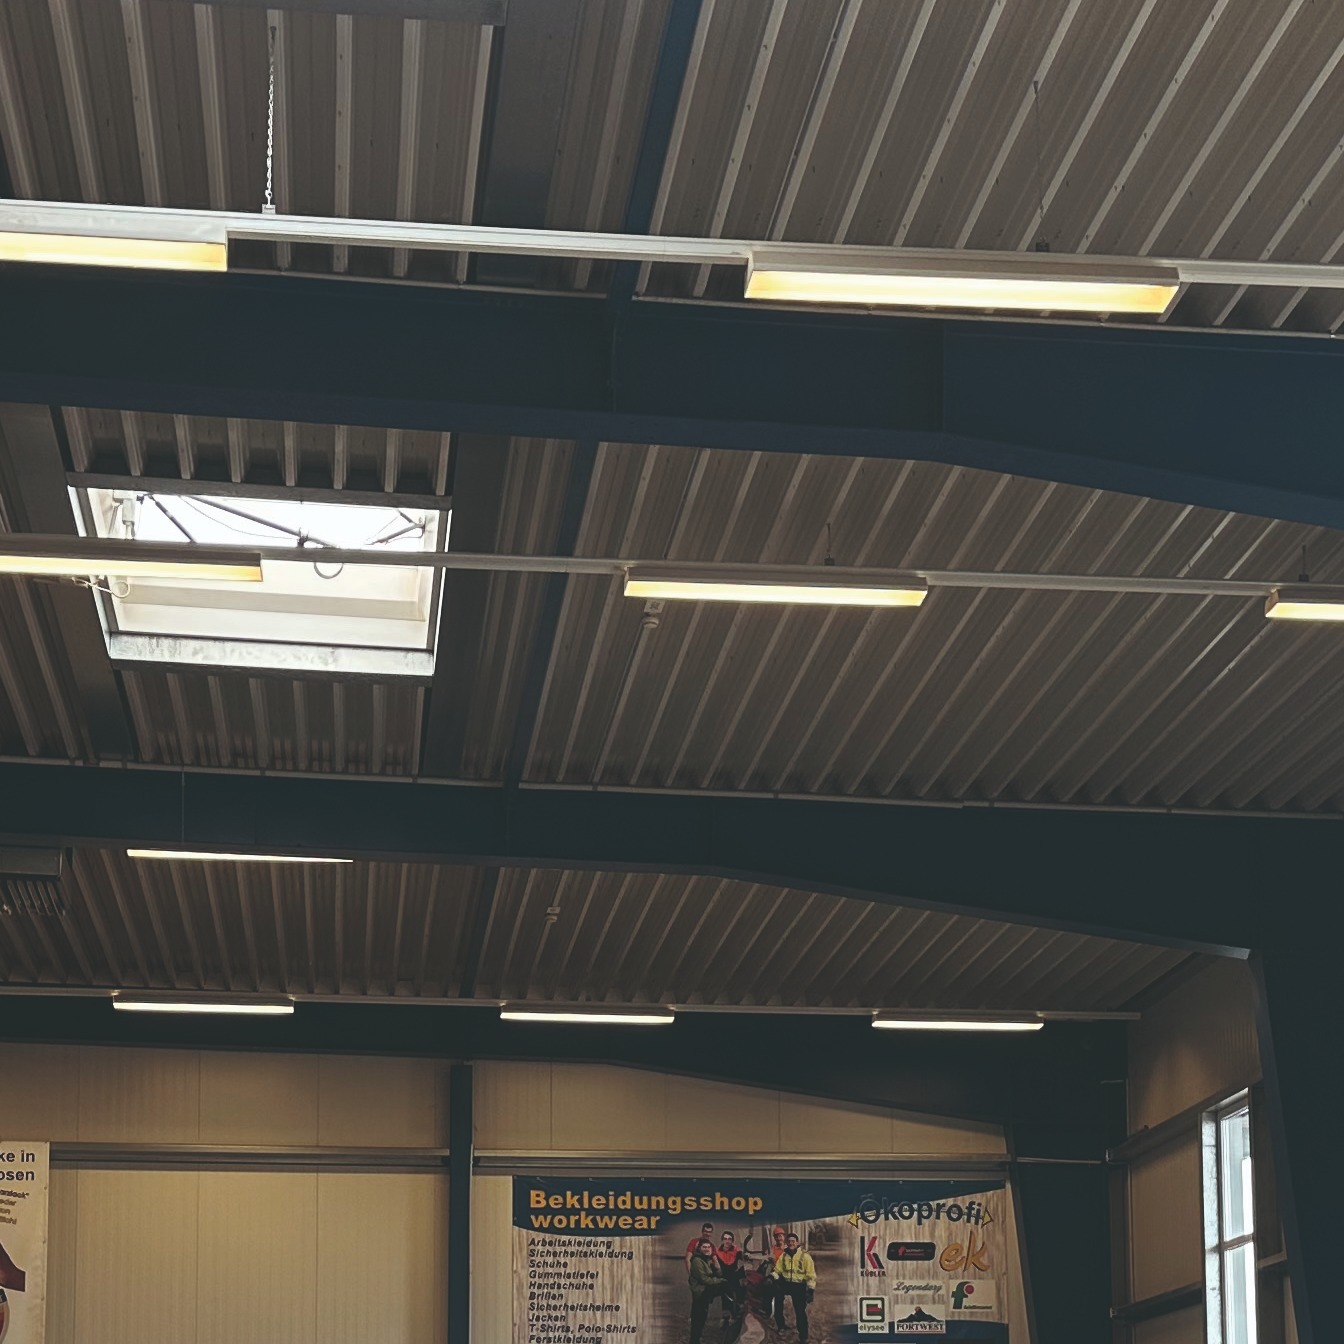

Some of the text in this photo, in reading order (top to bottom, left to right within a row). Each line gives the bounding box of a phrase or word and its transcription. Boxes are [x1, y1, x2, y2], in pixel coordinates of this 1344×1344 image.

[20, 1150, 35, 1163] in
[530, 1190, 763, 1215] Bekleidungsshop
[859, 1193, 982, 1225] Ökoprofi
[530, 1211, 661, 1229] workwear
[529, 1238, 613, 1249] Arbeitskleidung
[529, 1249, 633, 1260] Sicherheitskleidung
[939, 1231, 990, 1272] ek
[529, 1259, 568, 1268] Schuhe
[529, 1270, 599, 1279] Gummistiefel
[860, 1269, 886, 1277] KÜBLER
[529, 1281, 594, 1290] Handschuhe
[893, 1280, 943, 1294] Legendary
[529, 1292, 564, 1300] Brillen
[529, 1302, 621, 1312] Sicherheitshelme
[529, 1313, 566, 1322] Jacken
[530, 1324, 637, 1334] T-Shirts, Polo-Shirts
[859, 1324, 885, 1332] elysee
[897, 1323, 944, 1331] FORTWEST
[529, 1335, 602, 1344] Forstkleidung
